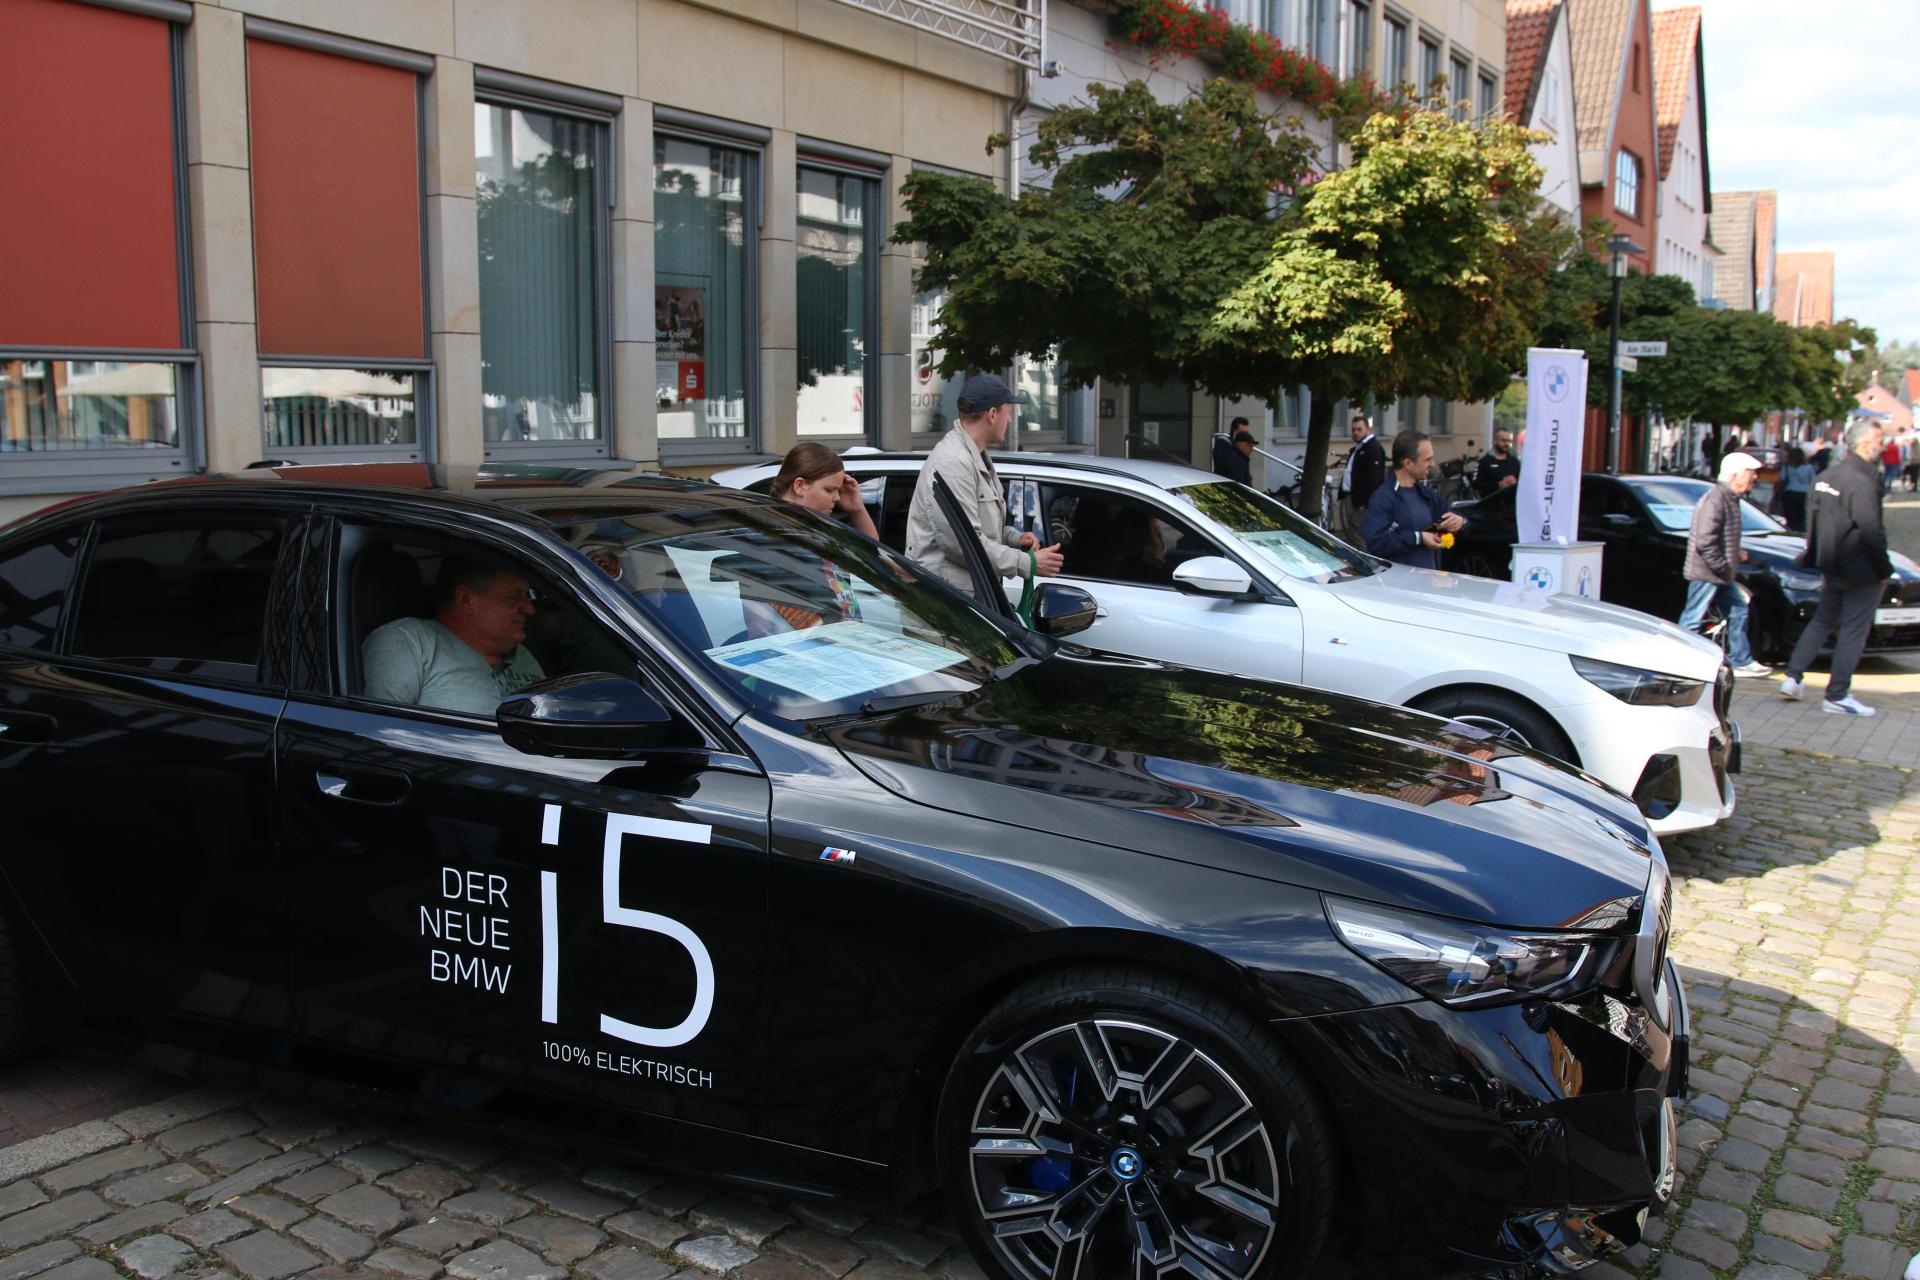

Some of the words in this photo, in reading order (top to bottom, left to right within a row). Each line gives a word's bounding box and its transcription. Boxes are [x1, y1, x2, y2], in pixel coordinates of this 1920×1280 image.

[656, 329, 667, 338] ber
[656, 340, 684, 350] prechen?
[442, 866, 509, 908] DER
[420, 905, 510, 951] NEUE
[540, 803, 715, 1048] i5
[431, 949, 512, 994] BMW
[543, 1041, 591, 1066] 100%
[596, 1051, 713, 1089] ELEKTRISCH
